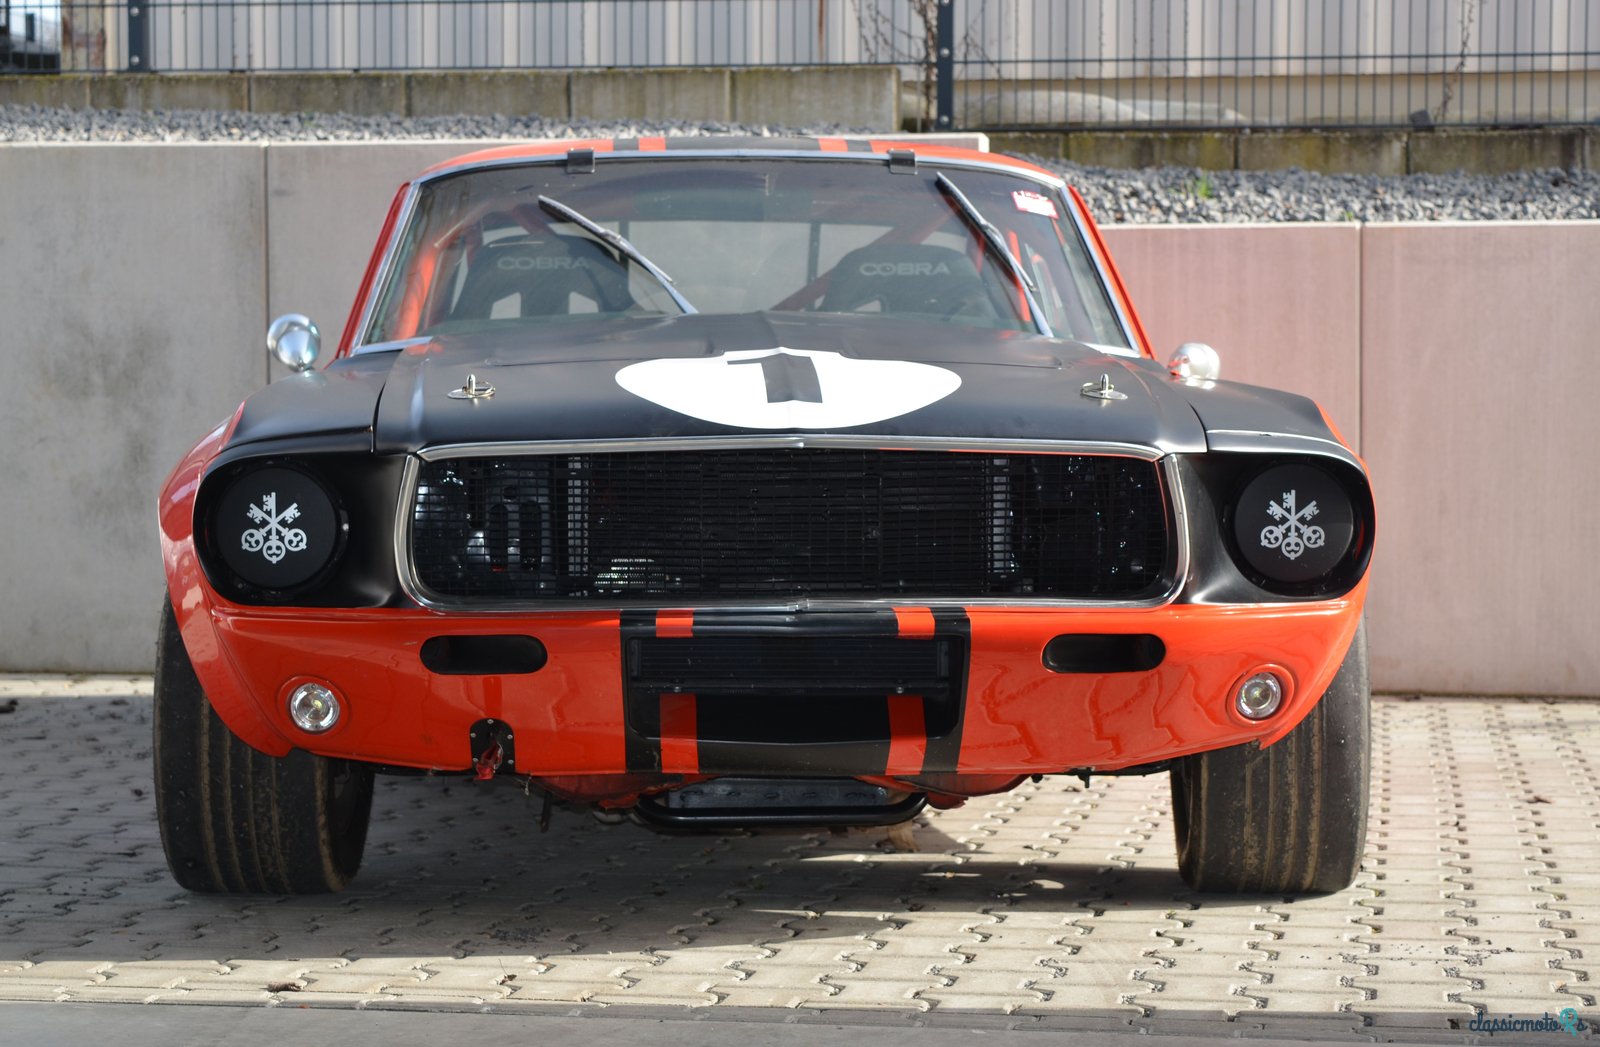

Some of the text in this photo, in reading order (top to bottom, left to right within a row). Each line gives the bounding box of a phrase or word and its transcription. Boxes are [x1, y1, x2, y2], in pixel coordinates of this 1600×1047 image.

[497, 256, 590, 270] COBRA
[860, 262, 951, 276] COBRA
[727, 352, 823, 403] 1
